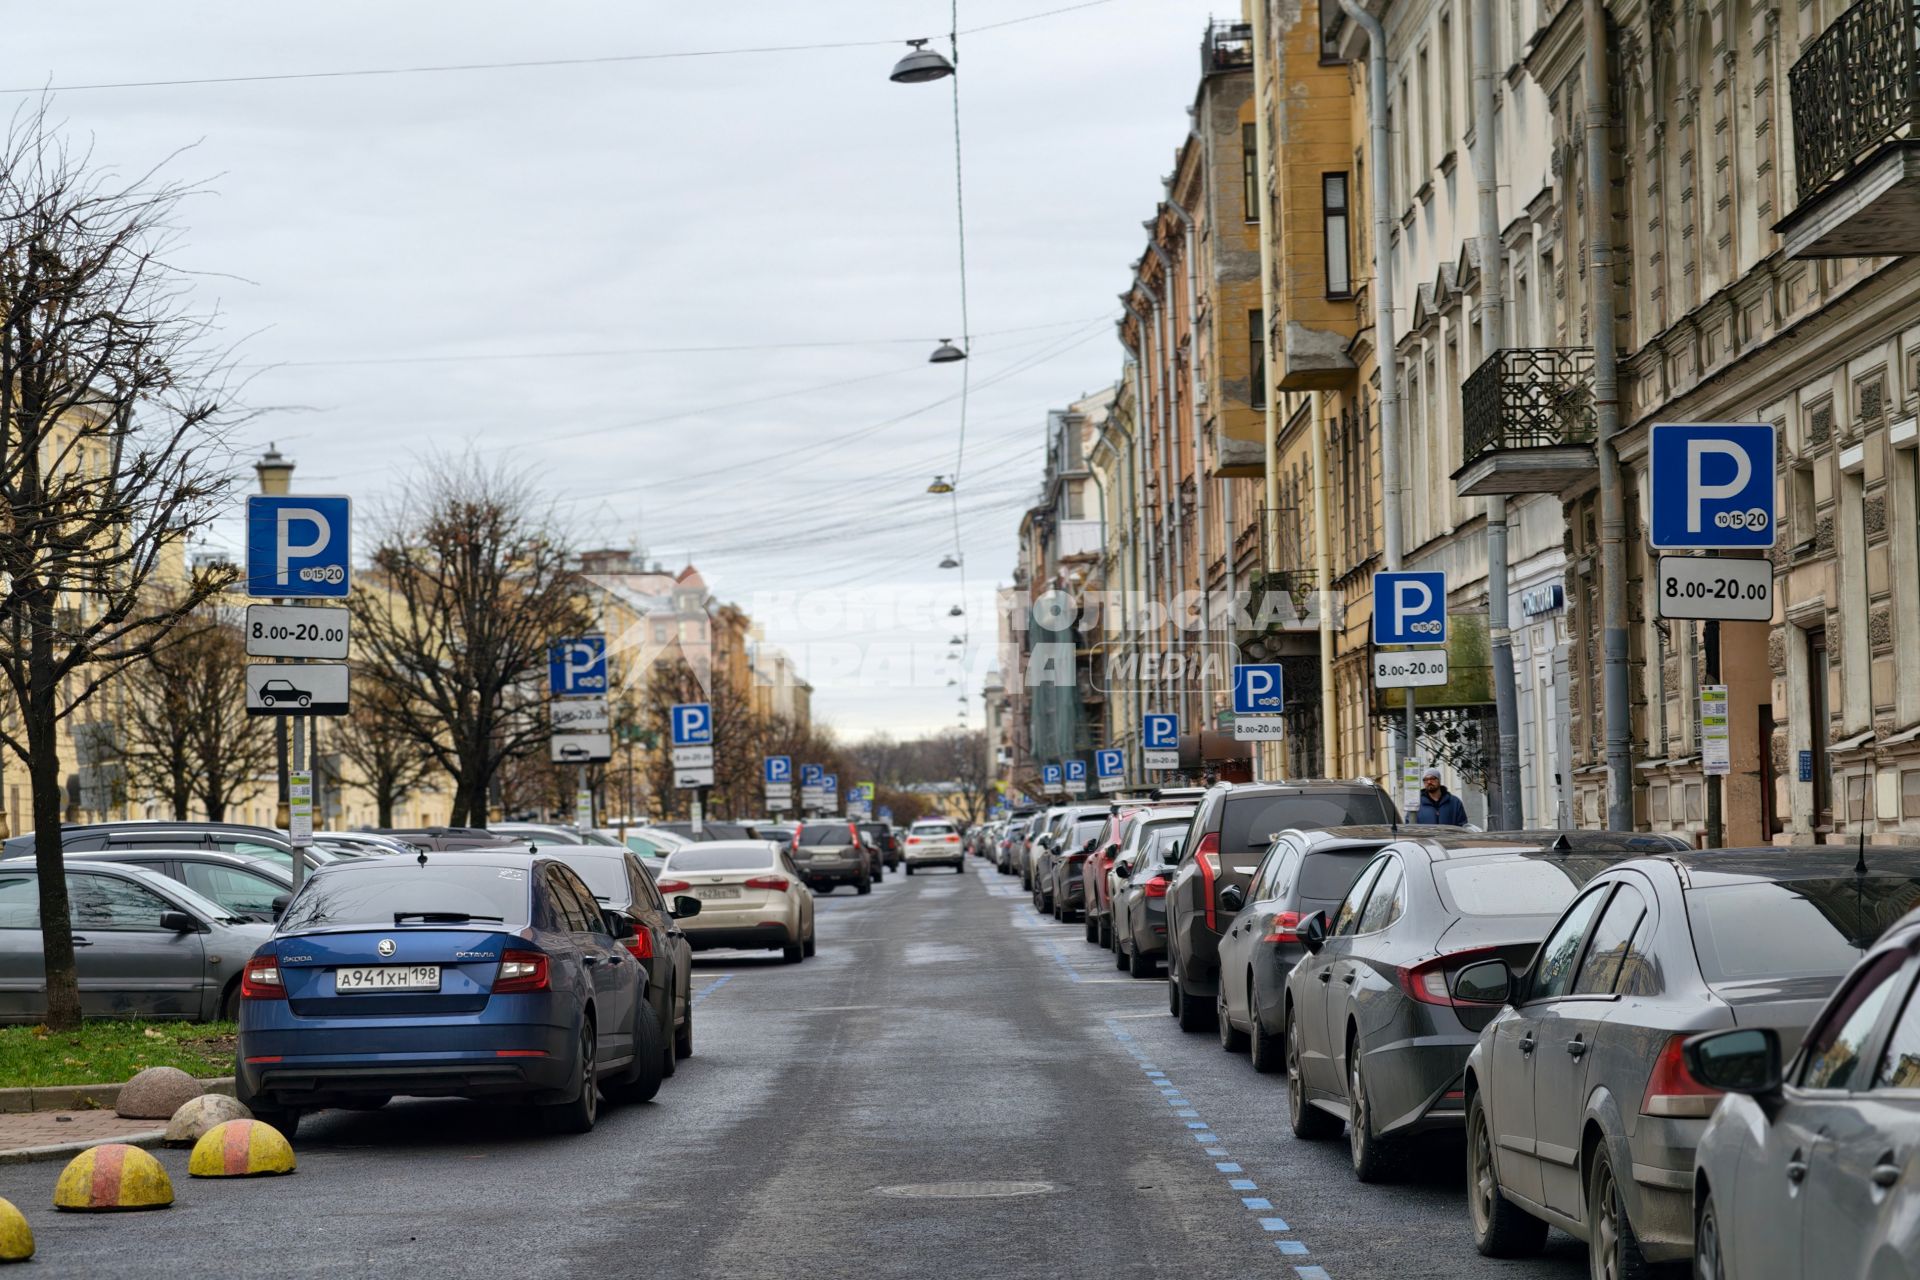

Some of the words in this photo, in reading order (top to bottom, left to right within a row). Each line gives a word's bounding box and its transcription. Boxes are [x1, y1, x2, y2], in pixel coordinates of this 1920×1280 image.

[1687, 439, 1752, 533] P
[1718, 515, 1728, 524] 10
[1731, 514, 1743, 525] 15
[1748, 513, 1766, 526] 20
[277, 508, 331, 585] P
[302, 570, 311, 579] 10
[313, 569, 324, 580] 15
[326, 567, 343, 580] 20
[1665, 577, 1767, 600] 8.00-20.00
[1394, 580, 1433, 636] P
[252, 622, 344, 642] 8.00-20.00
[1420, 623, 1428, 631] 15
[1430, 622, 1441, 631] 20
[564, 643, 595, 690] P
[1378, 662, 1444, 677] 8.00-20.00
[1247, 670, 1273, 707] P
[682, 708, 704, 740] P
[1153, 718, 1172, 745] P
[1237, 724, 1281, 734] 8.00-20.00
[771, 760, 786, 779] P
[1070, 763, 1082, 779] P
[1103, 753, 1119, 774] P
[1048, 768, 1058, 782] P
[341, 967, 408, 987] А941ХН
[411, 967, 437, 980] 198
